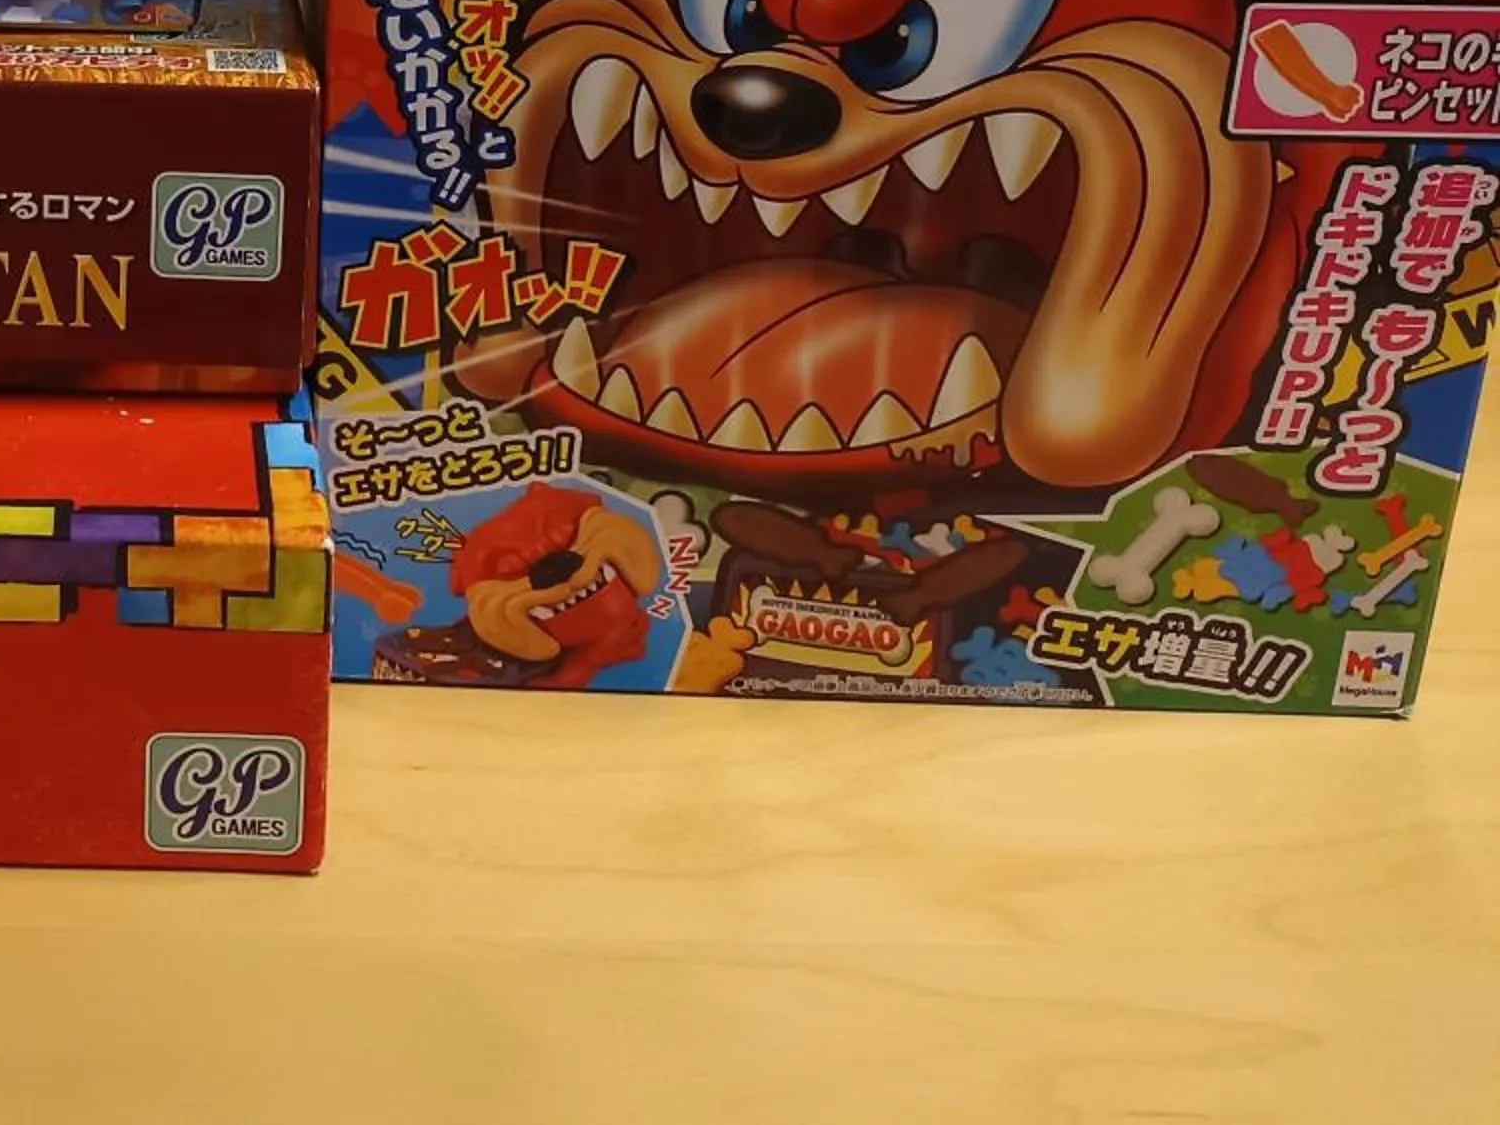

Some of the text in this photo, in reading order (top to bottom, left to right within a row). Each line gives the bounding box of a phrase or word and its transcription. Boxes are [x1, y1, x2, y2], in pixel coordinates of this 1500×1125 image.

[1379, 28, 1500, 73] ネコの
[205, 248, 266, 268] GAMES
[755, 608, 902, 653] GAOGAO
[211, 818, 285, 838] GAMES
